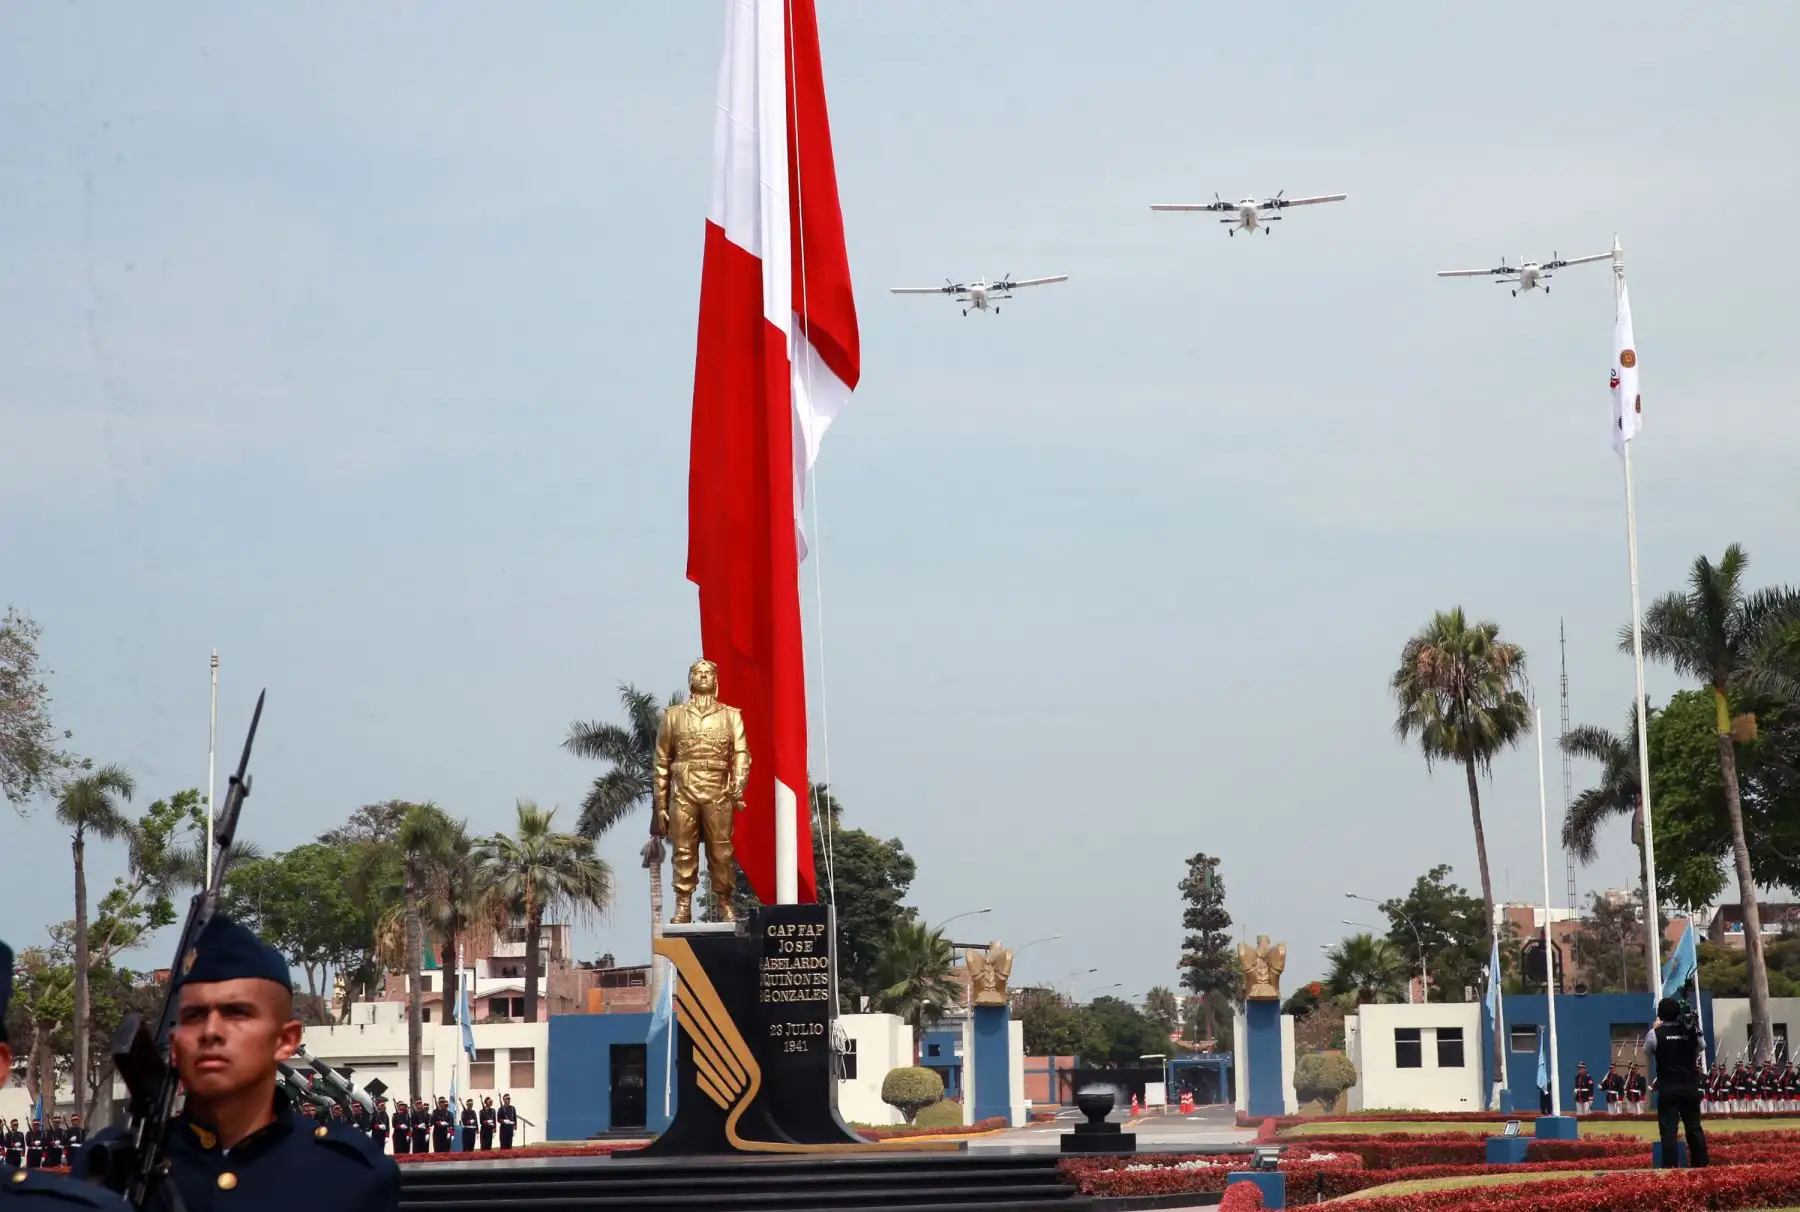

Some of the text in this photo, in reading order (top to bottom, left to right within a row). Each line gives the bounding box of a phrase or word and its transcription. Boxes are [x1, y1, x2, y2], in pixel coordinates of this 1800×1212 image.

[767, 924, 825, 937] CAP FAP
[778, 940, 814, 953] JOSE
[763, 957, 829, 970] ABELARDO
[763, 971, 829, 987] QUIÑONES
[764, 988, 829, 1002] GONZALES
[769, 1022, 825, 1036] 23 JULIO
[783, 1040, 809, 1053] 1941
